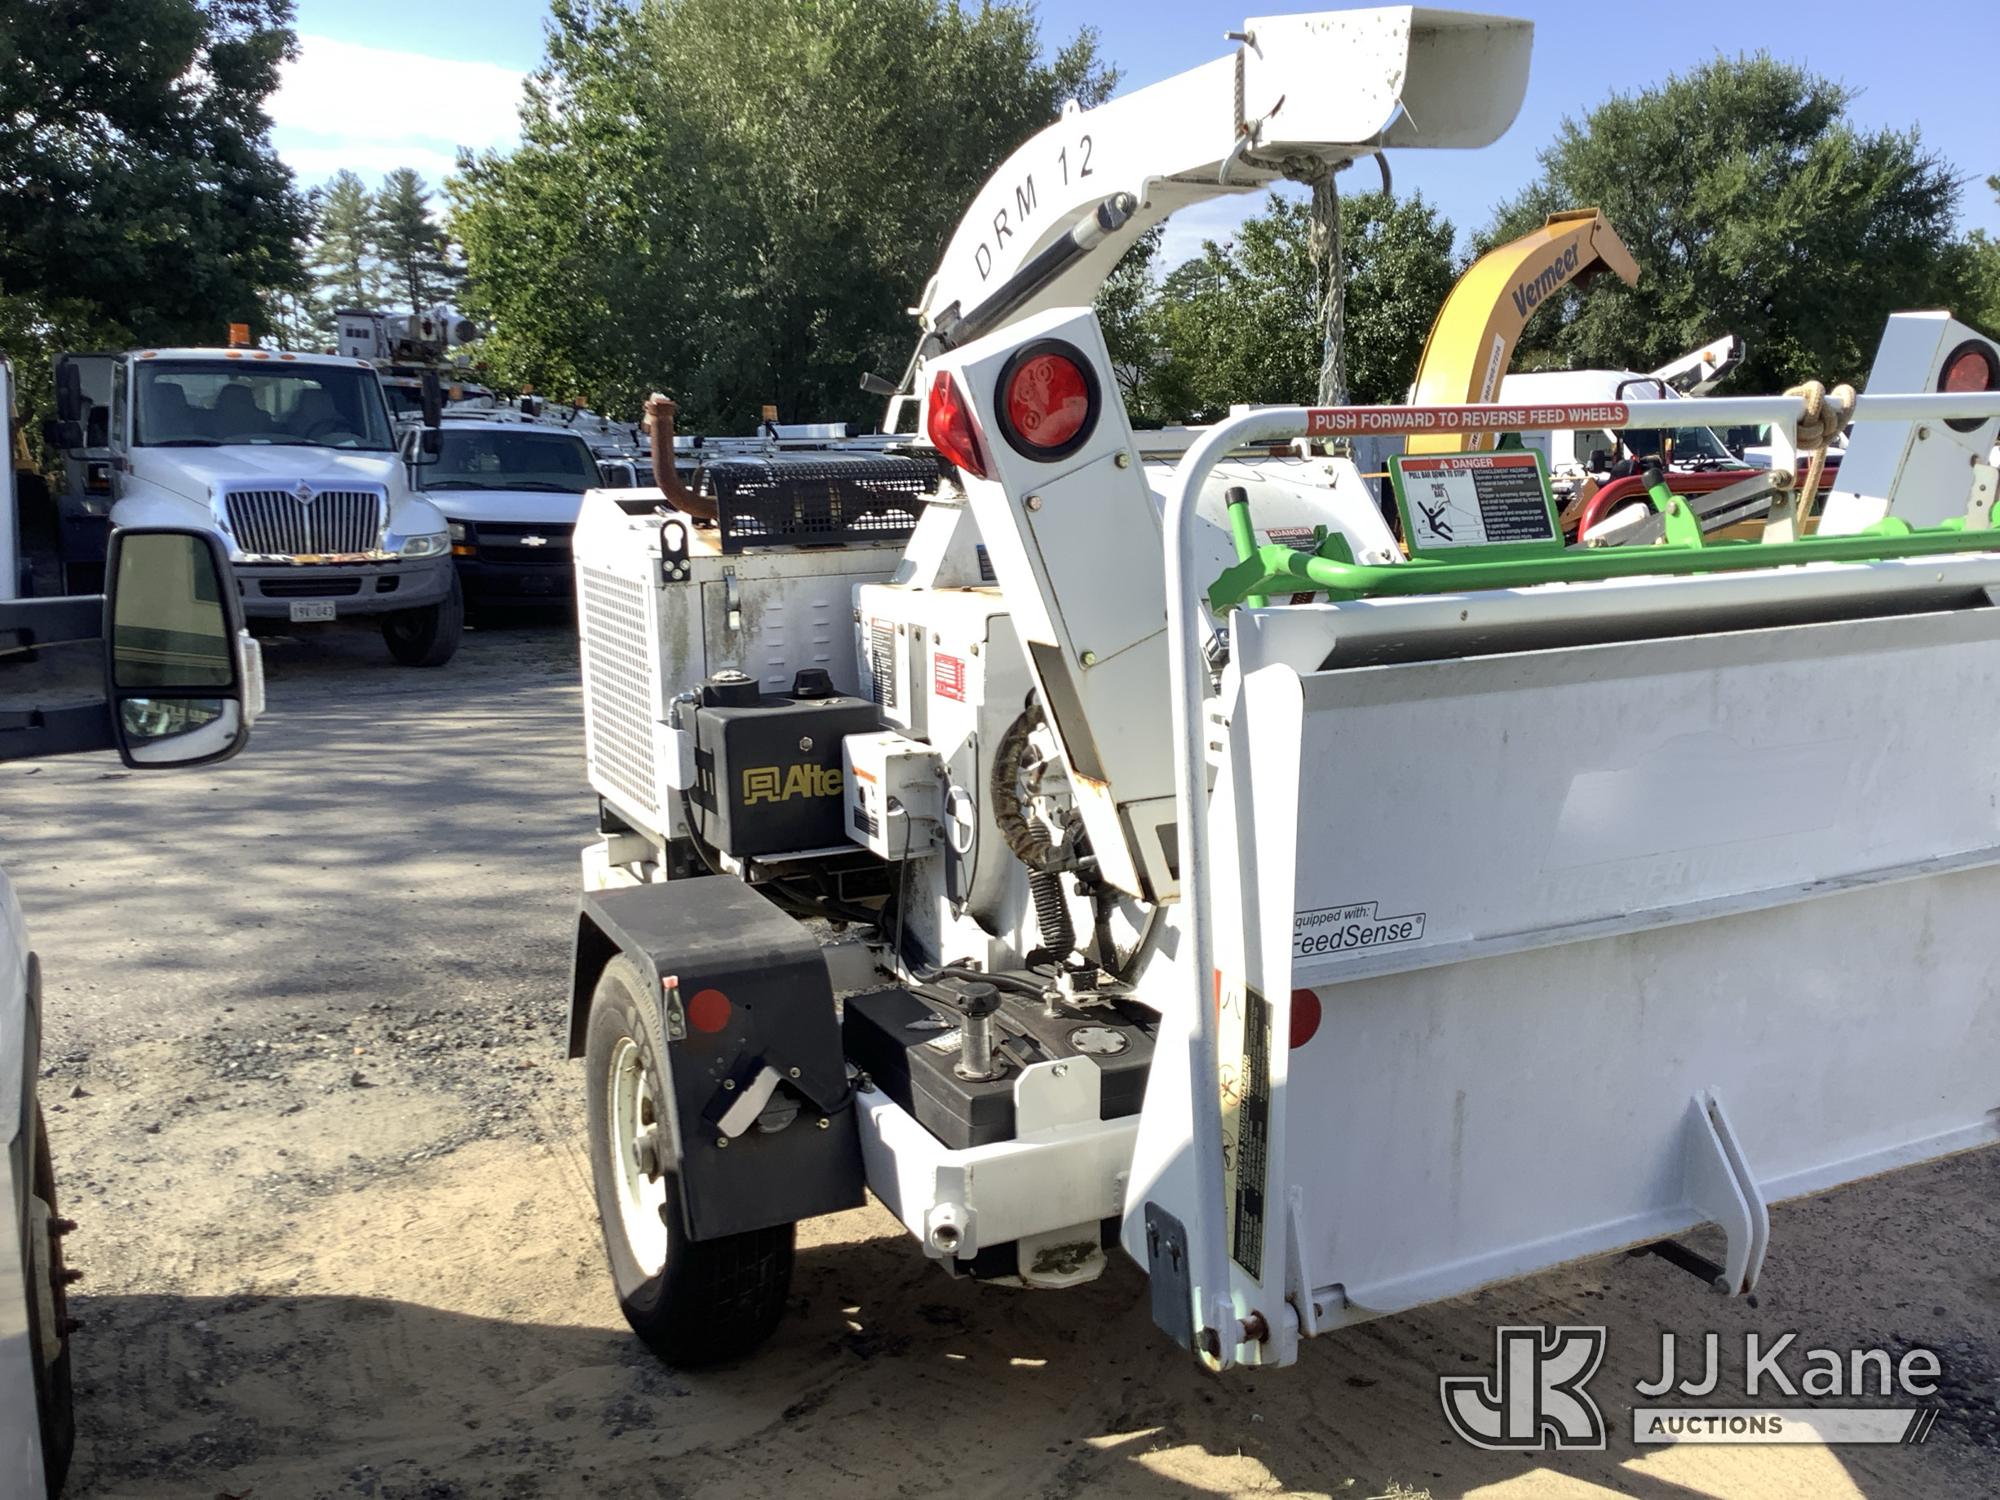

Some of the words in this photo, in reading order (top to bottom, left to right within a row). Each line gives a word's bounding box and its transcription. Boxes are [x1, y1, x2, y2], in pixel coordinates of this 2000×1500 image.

[975, 173, 1037, 282] DRM
[1058, 135, 1093, 186] 12
[1512, 241, 1579, 318] Vermeer
[1315, 414, 1356, 430] PUSH
[1360, 412, 1435, 429] FORWARD
[1439, 412, 1458, 427] TO
[1461, 410, 1526, 427] REVERSE
[1529, 408, 1566, 424] FEED
[1568, 406, 1624, 422] WHEELS
[1408, 471, 1421, 479] PULL
[1452, 458, 1494, 469] DANGER
[1275, 528, 1311, 536] DANGER
[782, 763, 843, 800] Alte
[1295, 909, 1342, 928] quipped
[1344, 905, 1371, 920] with:
[1240, 1054, 1249, 1101] HAZARD
[1239, 1103, 1247, 1141] CRUSH
